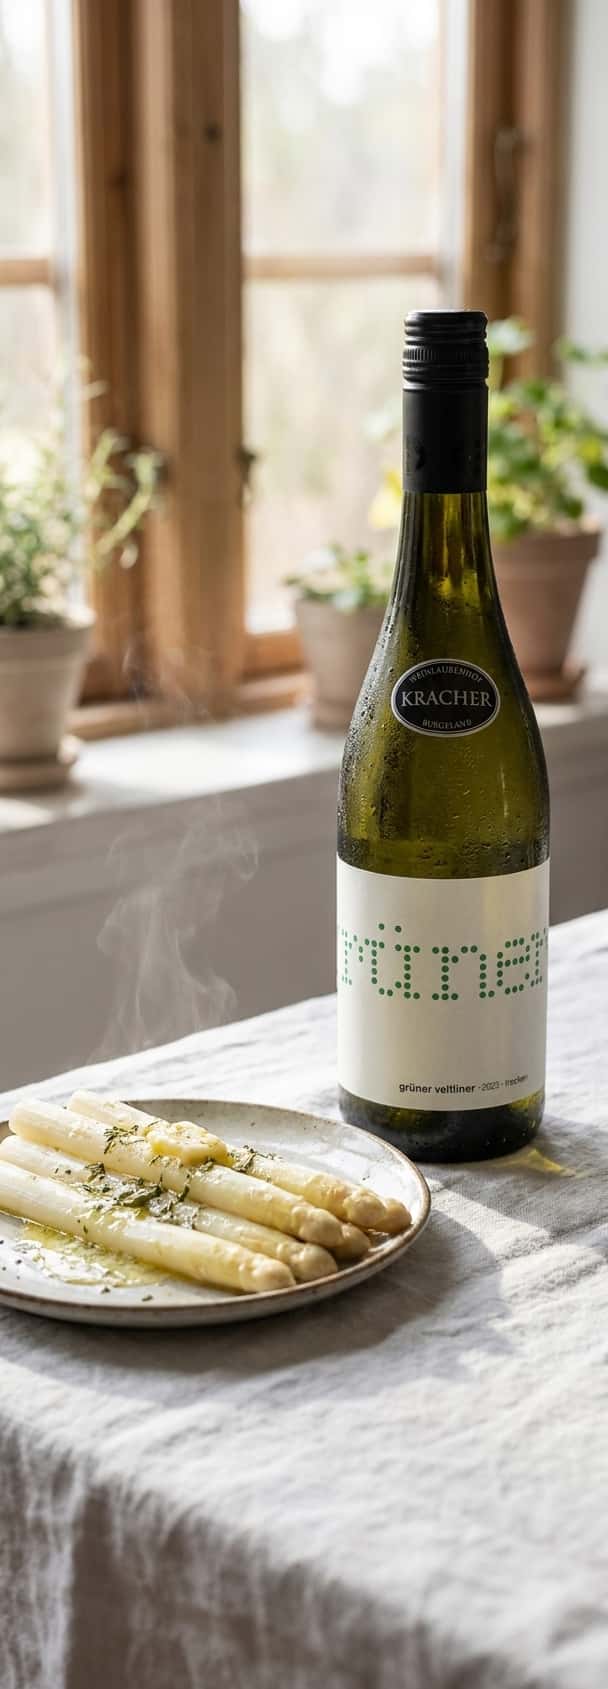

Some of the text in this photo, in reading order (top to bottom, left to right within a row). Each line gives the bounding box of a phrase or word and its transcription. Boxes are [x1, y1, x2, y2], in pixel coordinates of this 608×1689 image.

[401, 689, 493, 707] KRACHER
[399, 1082, 432, 1094] grüner
[435, 1084, 476, 1094] veltliner
